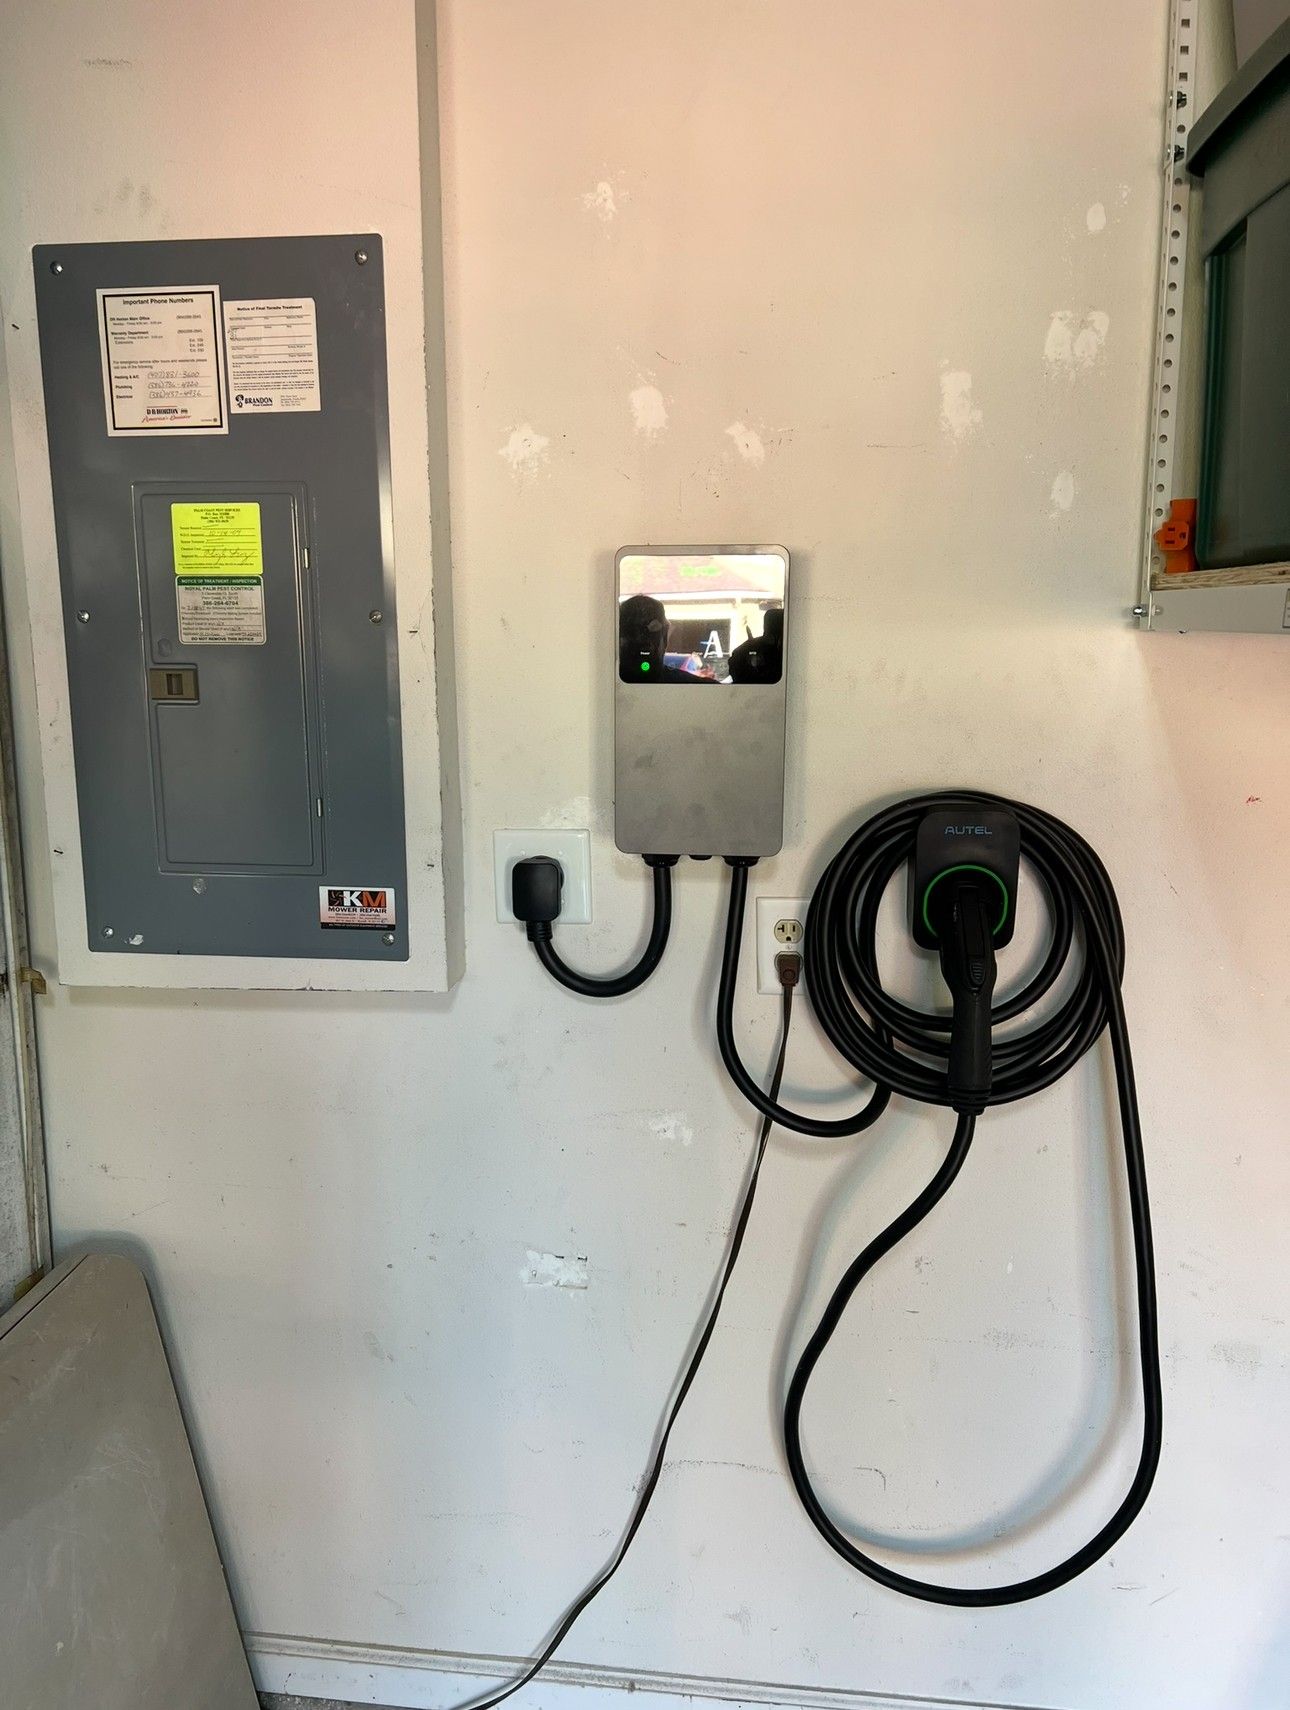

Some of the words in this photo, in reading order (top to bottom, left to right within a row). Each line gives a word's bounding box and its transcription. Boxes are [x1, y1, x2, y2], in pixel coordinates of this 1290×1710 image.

[123, 298, 149, 306] Important
[944, 826, 993, 835] AUTEL
[343, 891, 386, 908] KM
